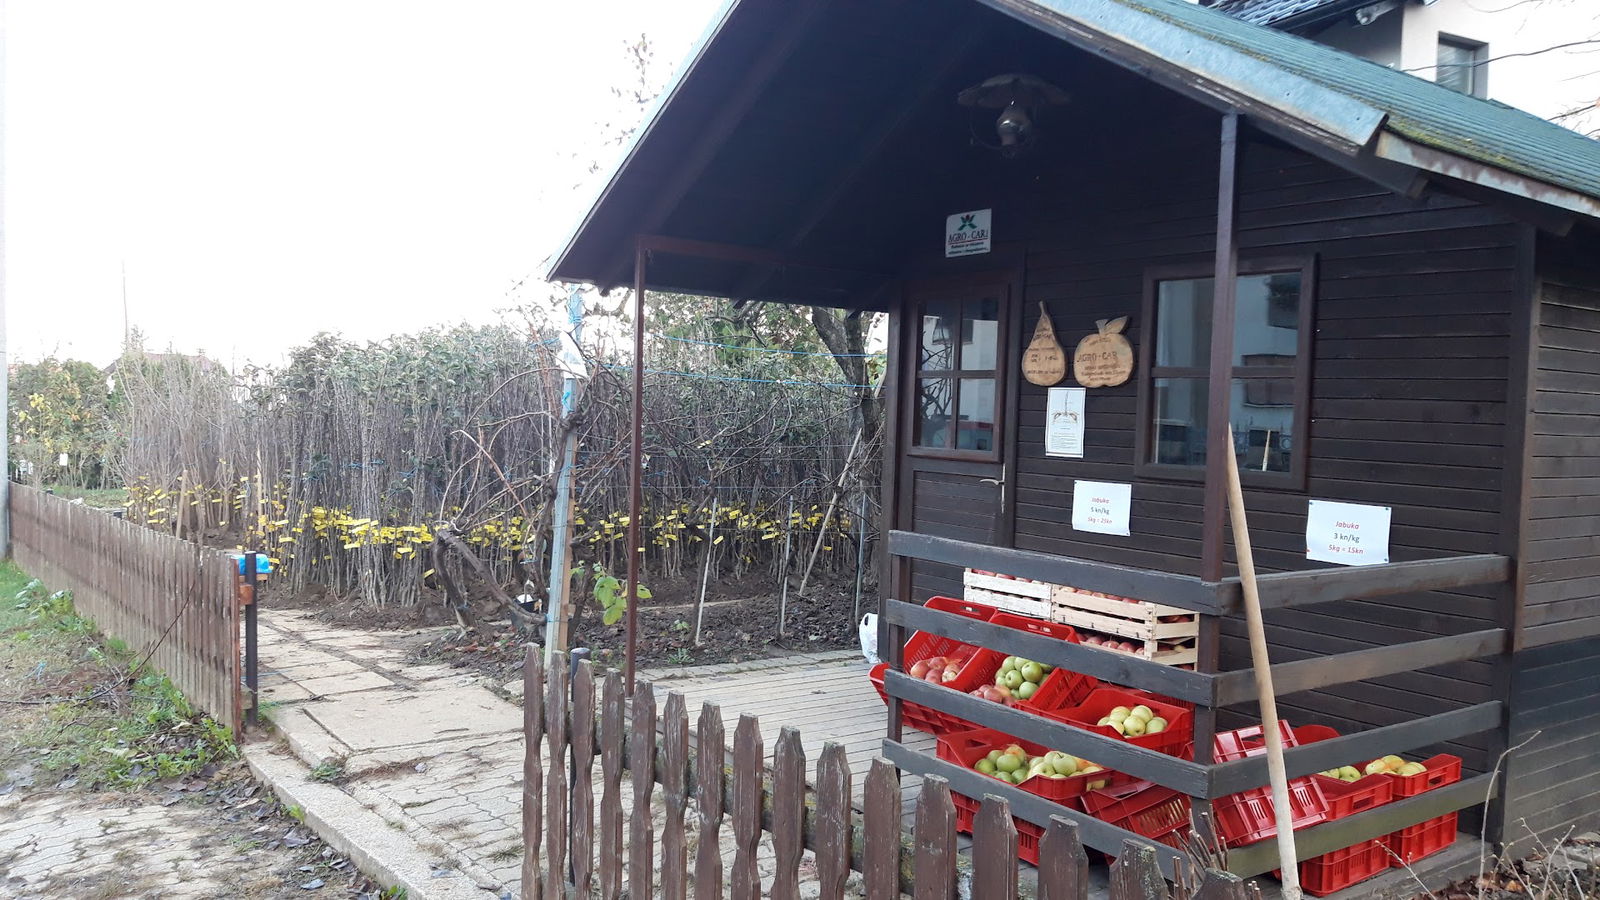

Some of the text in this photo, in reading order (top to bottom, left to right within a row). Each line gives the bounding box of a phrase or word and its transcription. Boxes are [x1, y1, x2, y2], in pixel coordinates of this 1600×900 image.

[948, 232, 967, 242] AGRO
[1335, 521, 1360, 529] Jabuka
[1334, 532, 1360, 543] 3 kn/kg
[1328, 544, 1341, 552] 5kg
[1347, 547, 1364, 555] 15kn
